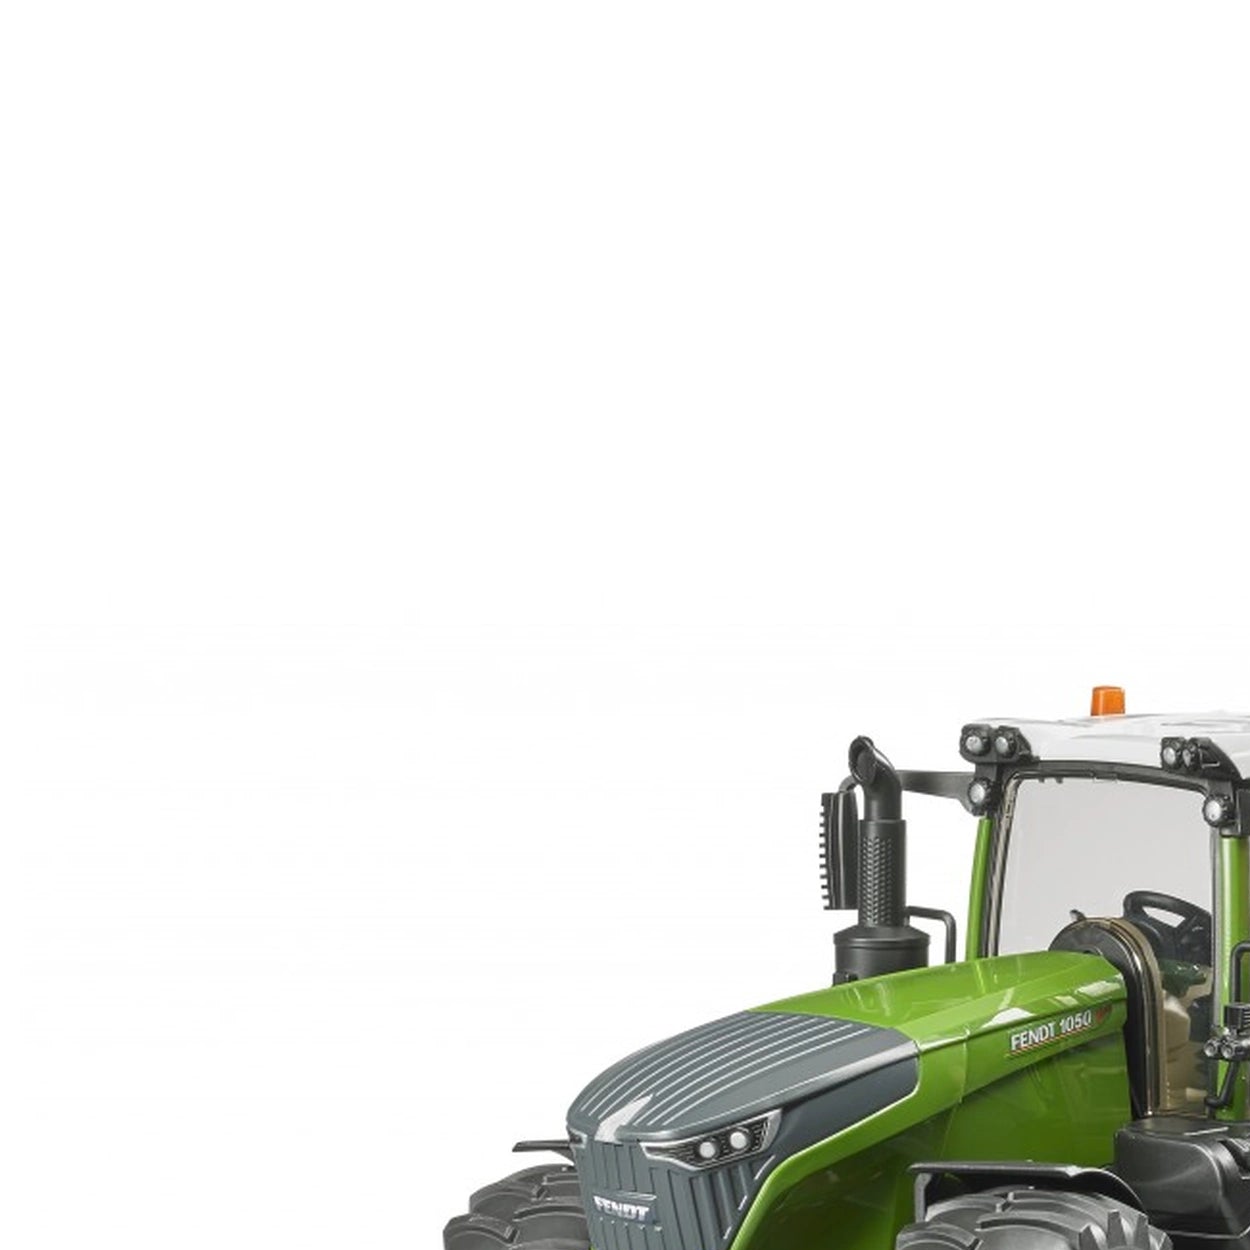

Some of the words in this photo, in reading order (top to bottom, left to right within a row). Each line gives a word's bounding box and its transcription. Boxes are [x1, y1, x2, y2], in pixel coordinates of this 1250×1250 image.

[1010, 1021, 1056, 1051] FENDT
[1059, 1009, 1092, 1034] 1050
[592, 1195, 650, 1221] FENDT
